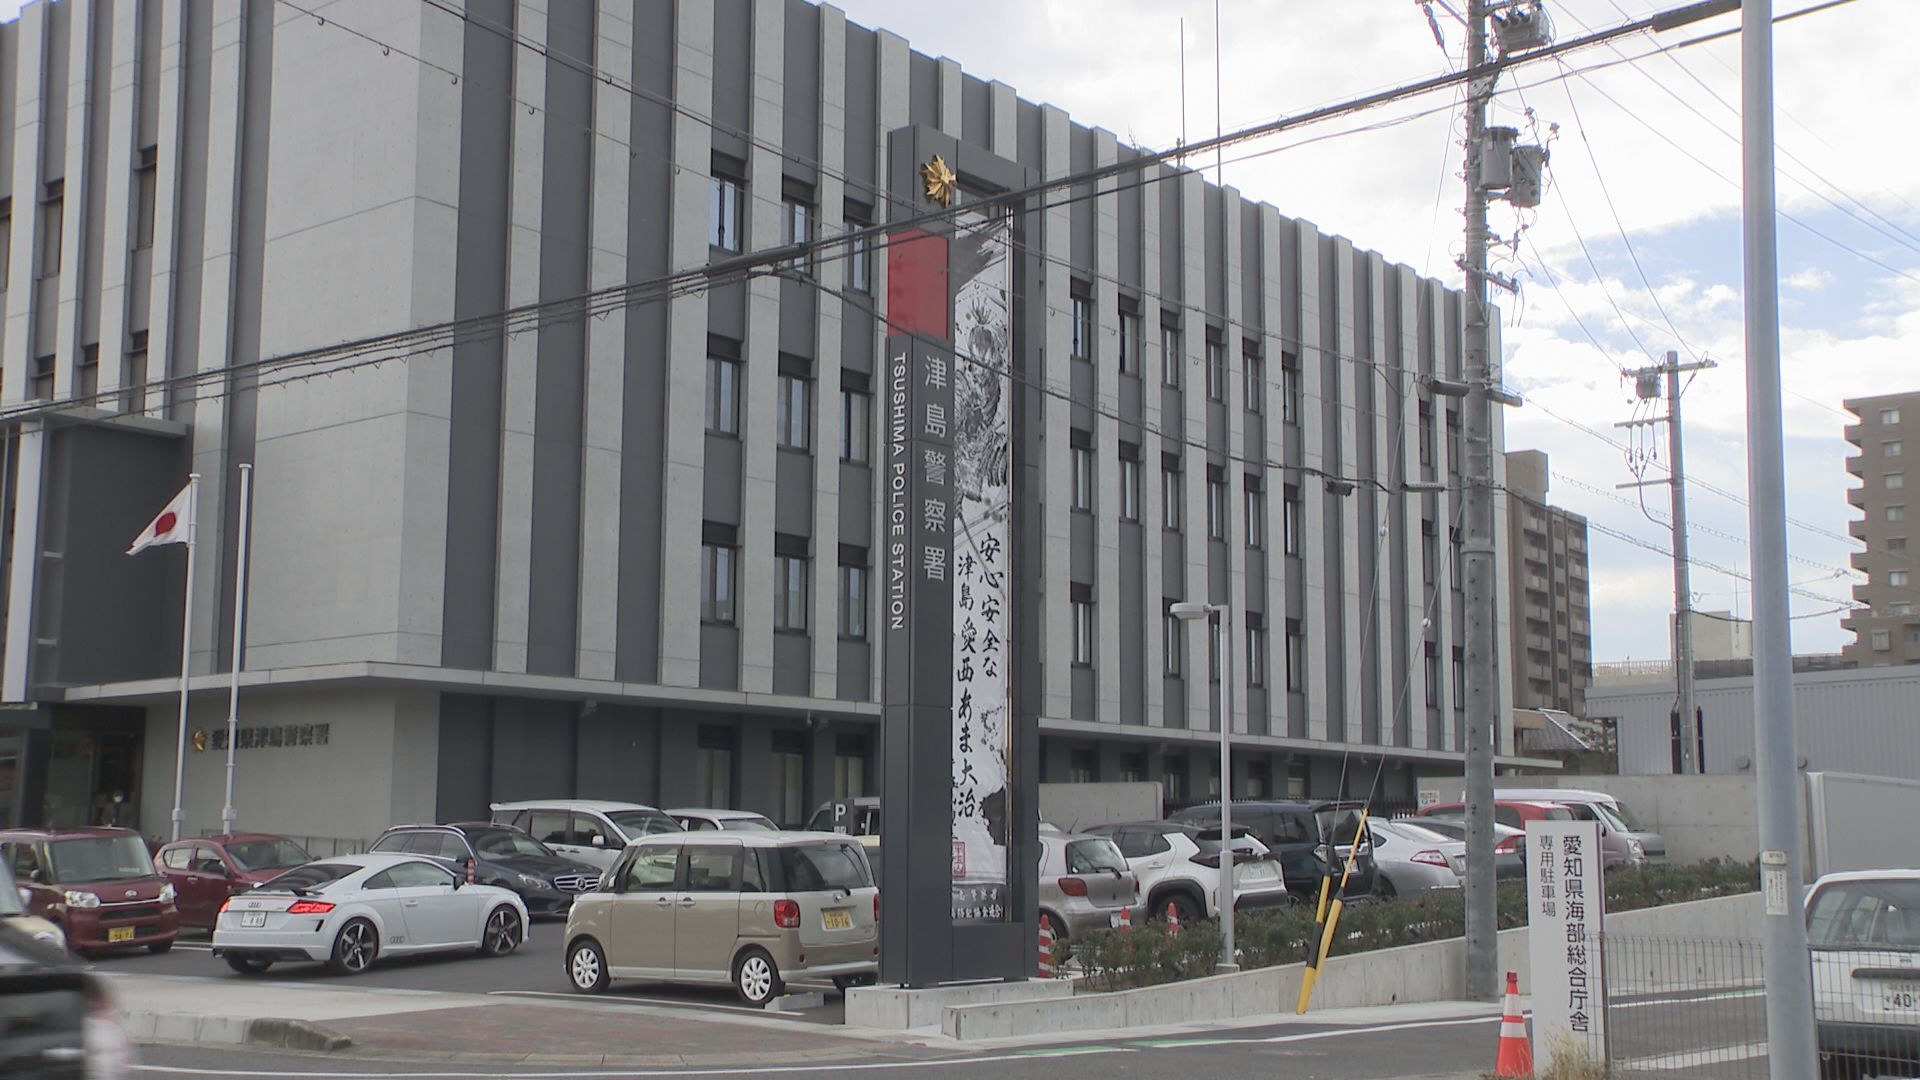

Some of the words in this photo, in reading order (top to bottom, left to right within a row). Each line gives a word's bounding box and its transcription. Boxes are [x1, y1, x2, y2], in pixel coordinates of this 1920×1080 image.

[892, 352, 906, 457] TSUSHIMA
[892, 463, 905, 536] POLICE
[923, 355, 948, 583] 津島警察署
[891, 544, 905, 630] STATION
[979, 532, 1004, 678] 安心安全な
[835, 804, 847, 822] P
[1539, 835, 1556, 917] 専用駐車場
[1563, 835, 1589, 1032] 愛知県海部総合庁舎
